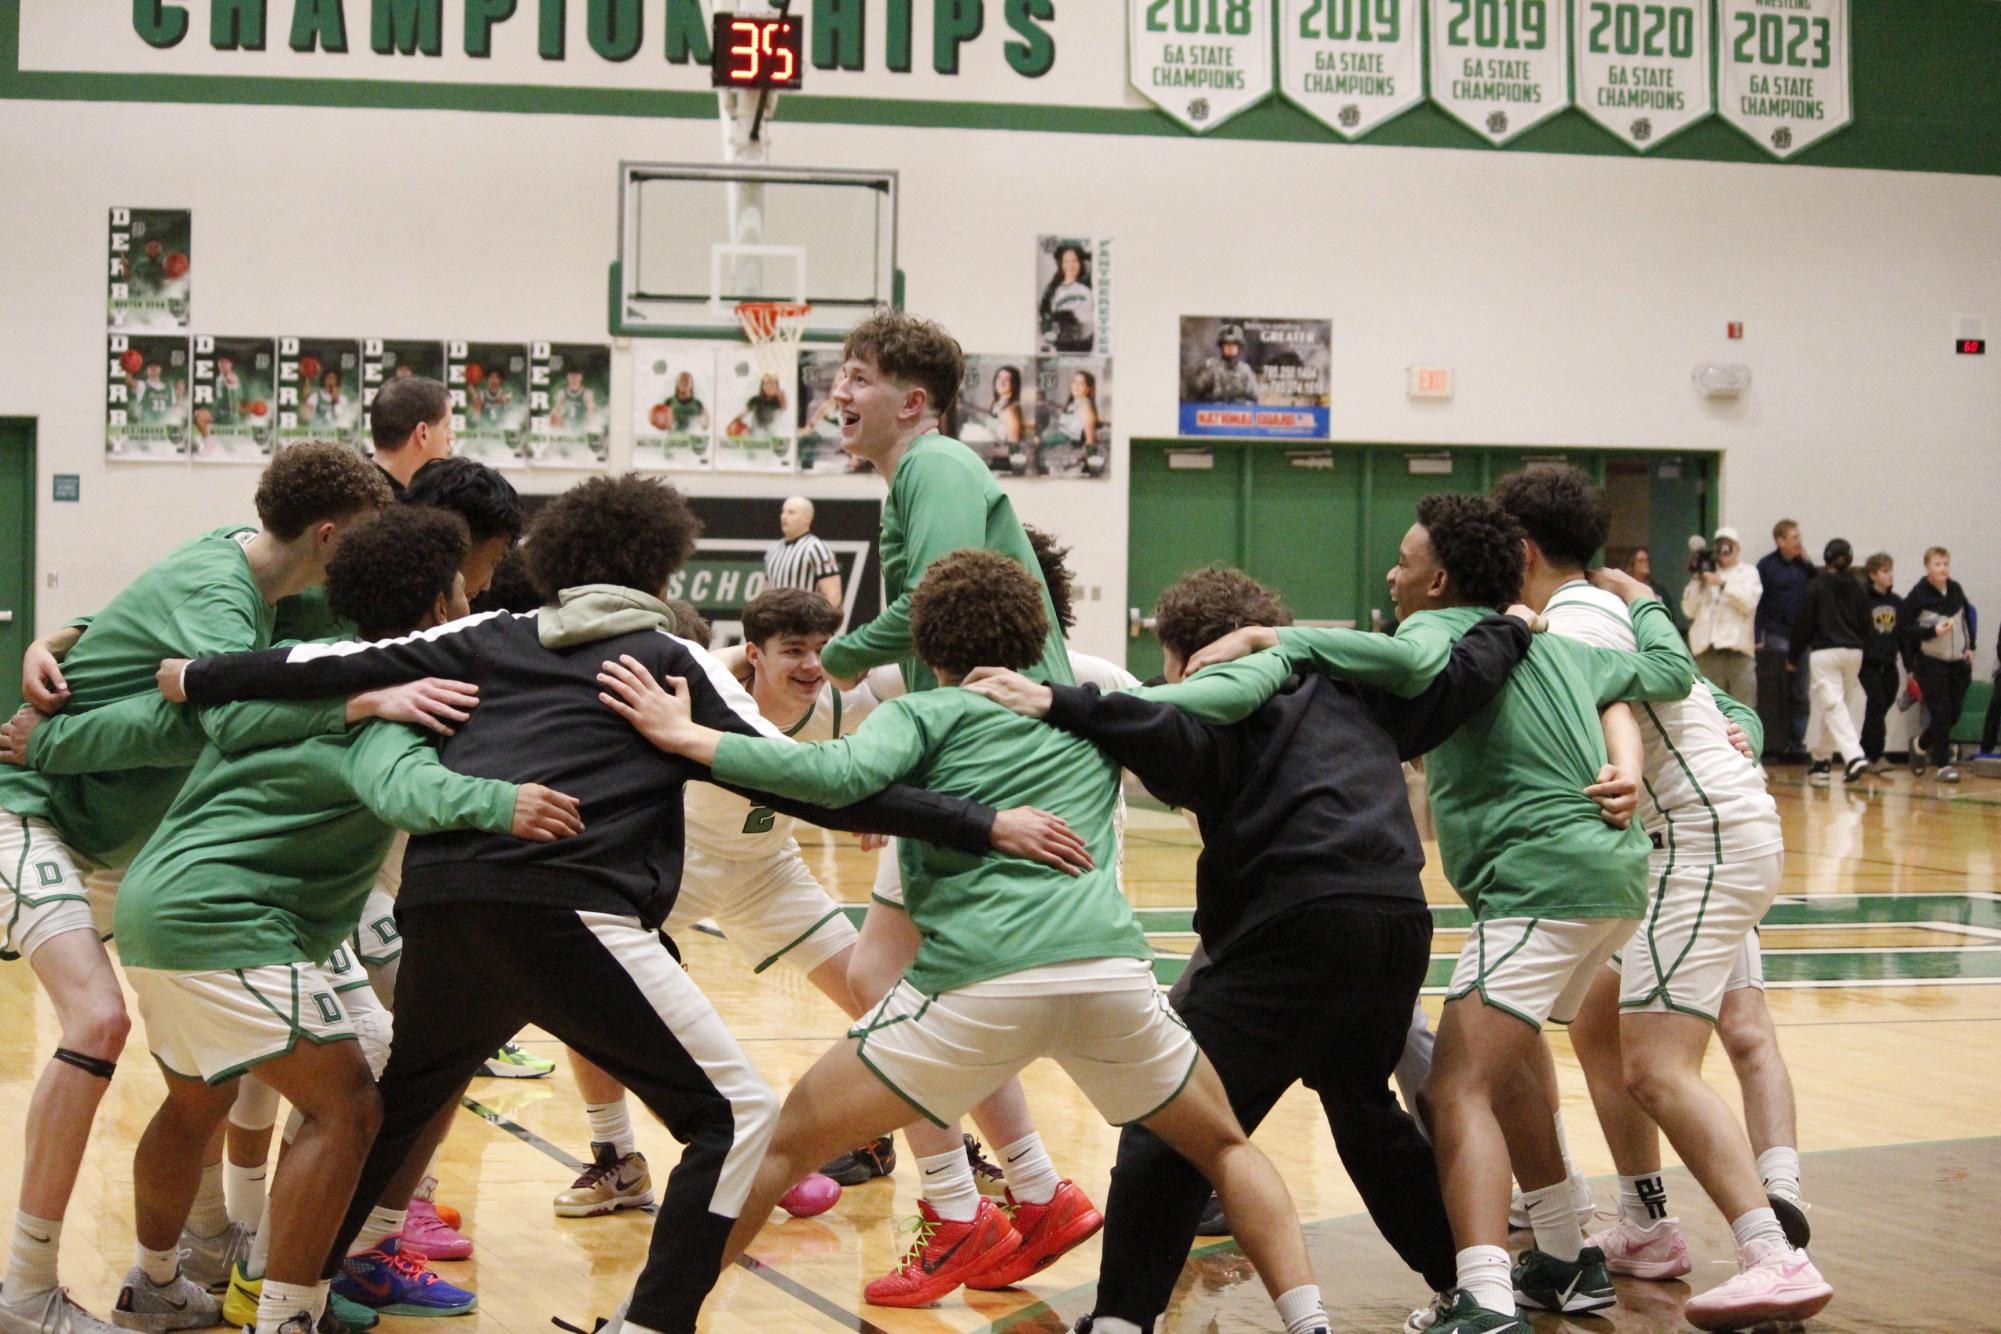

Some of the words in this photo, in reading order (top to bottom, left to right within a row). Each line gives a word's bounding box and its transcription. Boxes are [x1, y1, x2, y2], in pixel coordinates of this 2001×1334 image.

[1146, 0, 1252, 36] 2018
[1299, 0, 1401, 43] 2019
[1448, 0, 1547, 50] 2019
[1588, 2, 1694, 59] 2020
[132, 0, 1056, 78] CHAMPIONHIPS
[730, 22, 795, 81] 35
[1733, 11, 1831, 69] 2023
[1163, 44, 1184, 65] 6A
[1190, 46, 1234, 67] STATE
[1315, 51, 1336, 72] 6A
[1340, 53, 1384, 74] STATE
[1152, 66, 1246, 91] CHAMPIONS
[1463, 58, 1484, 79] 6A
[1488, 60, 1530, 80] STATE
[1608, 65, 1628, 86] 6A
[1632, 67, 1674, 88] STATE
[1304, 72, 1395, 97] CHAMPIONS
[1452, 80, 1541, 104] CHAMPIONS
[1750, 74, 1769, 95] 6A
[1773, 75, 1814, 98] STATE
[1597, 87, 1685, 111] CHAMPIONS
[1741, 95, 1825, 120] CHAMPIONS
[33, 861, 66, 888] D
[367, 914, 401, 947] D
[310, 991, 344, 1026] D
